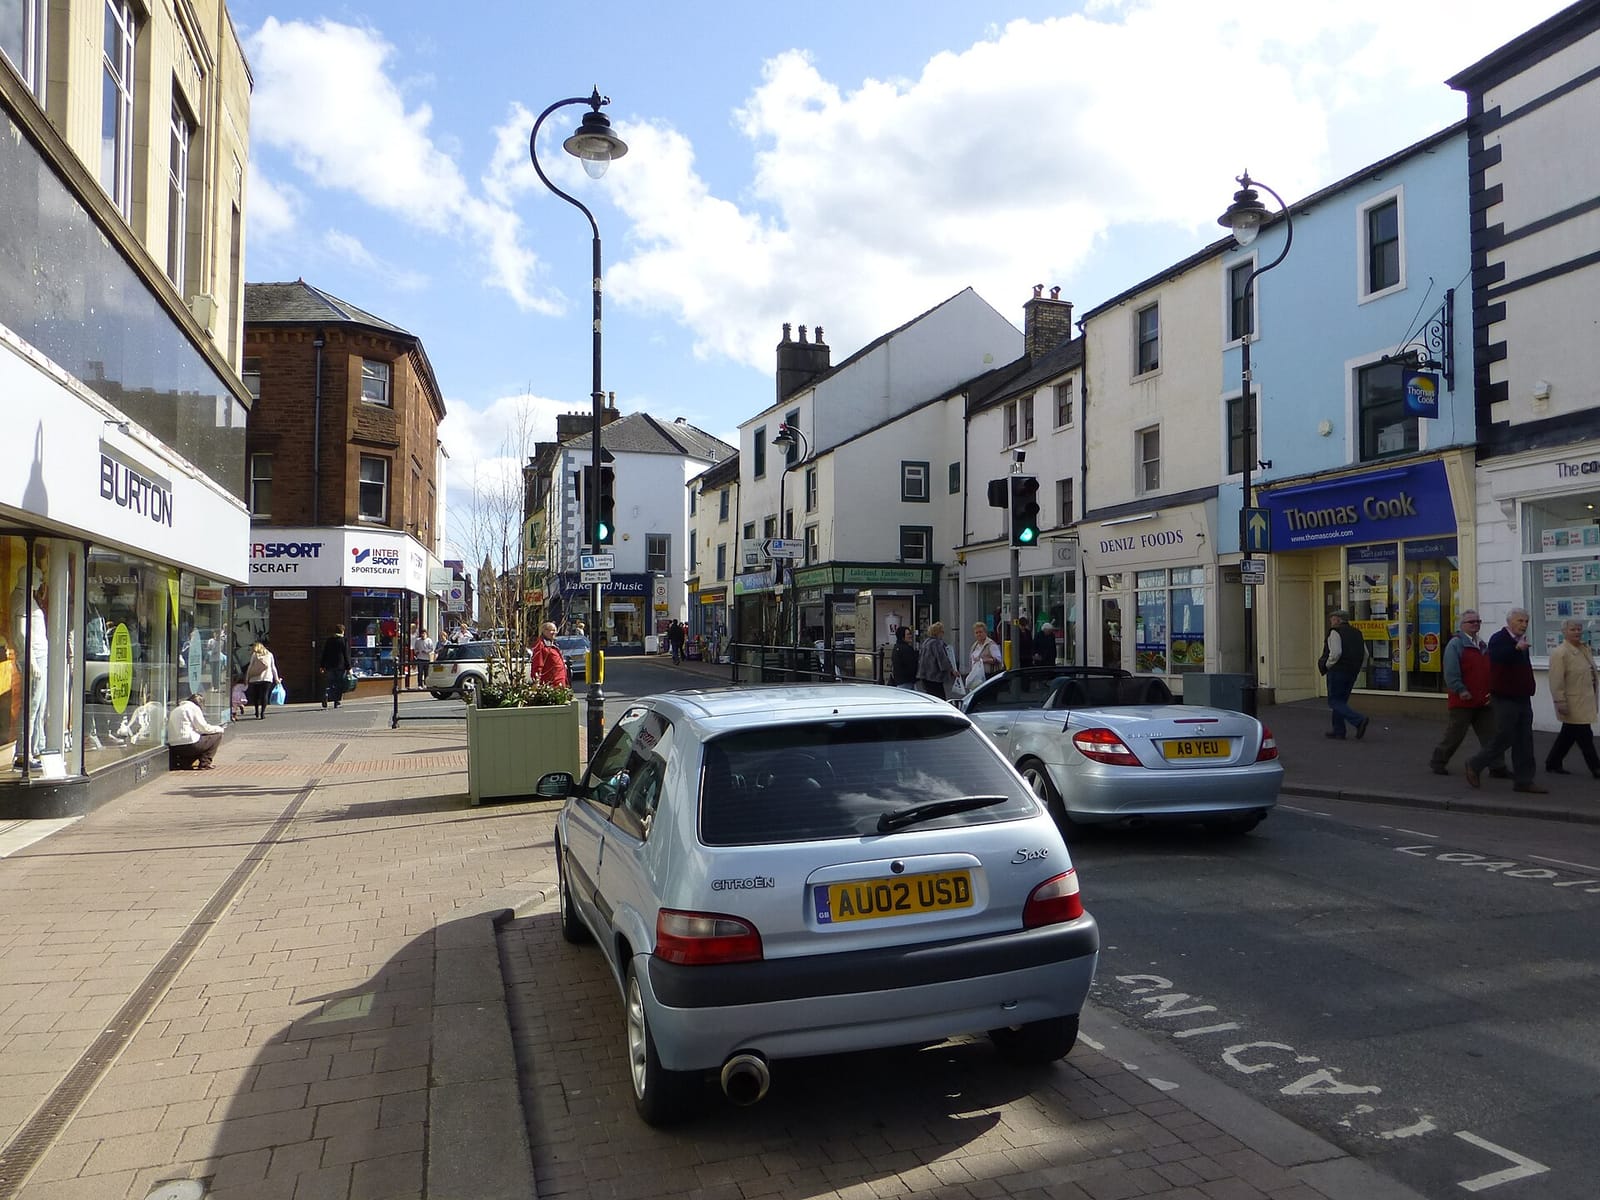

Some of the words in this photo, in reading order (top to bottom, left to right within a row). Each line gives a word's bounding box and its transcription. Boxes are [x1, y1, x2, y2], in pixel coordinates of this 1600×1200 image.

[1408, 386, 1435, 397] Thomas
[1417, 395, 1435, 405] Cook
[1555, 462, 1580, 478] The
[100, 454, 173, 528] BURTON
[1283, 504, 1359, 531] Thomas
[1363, 492, 1417, 521] Cook
[1100, 536, 1136, 554] DENIZ
[1141, 529, 1185, 547] FOODS
[1291, 529, 1354, 543] www.thomascook.com
[372, 548, 399, 558] INTER
[372, 557, 399, 566] SPORT
[351, 566, 401, 575] SPORTSCRAFT
[566, 581, 614, 590] Lakend
[614, 581, 643, 590] Music
[1177, 740, 1193, 755] A8
[1195, 740, 1219, 755] YEU
[1011, 848, 1048, 864] Saxo
[711, 875, 775, 891] CITROËN
[838, 882, 911, 917] AU02
[917, 876, 970, 907] USD
